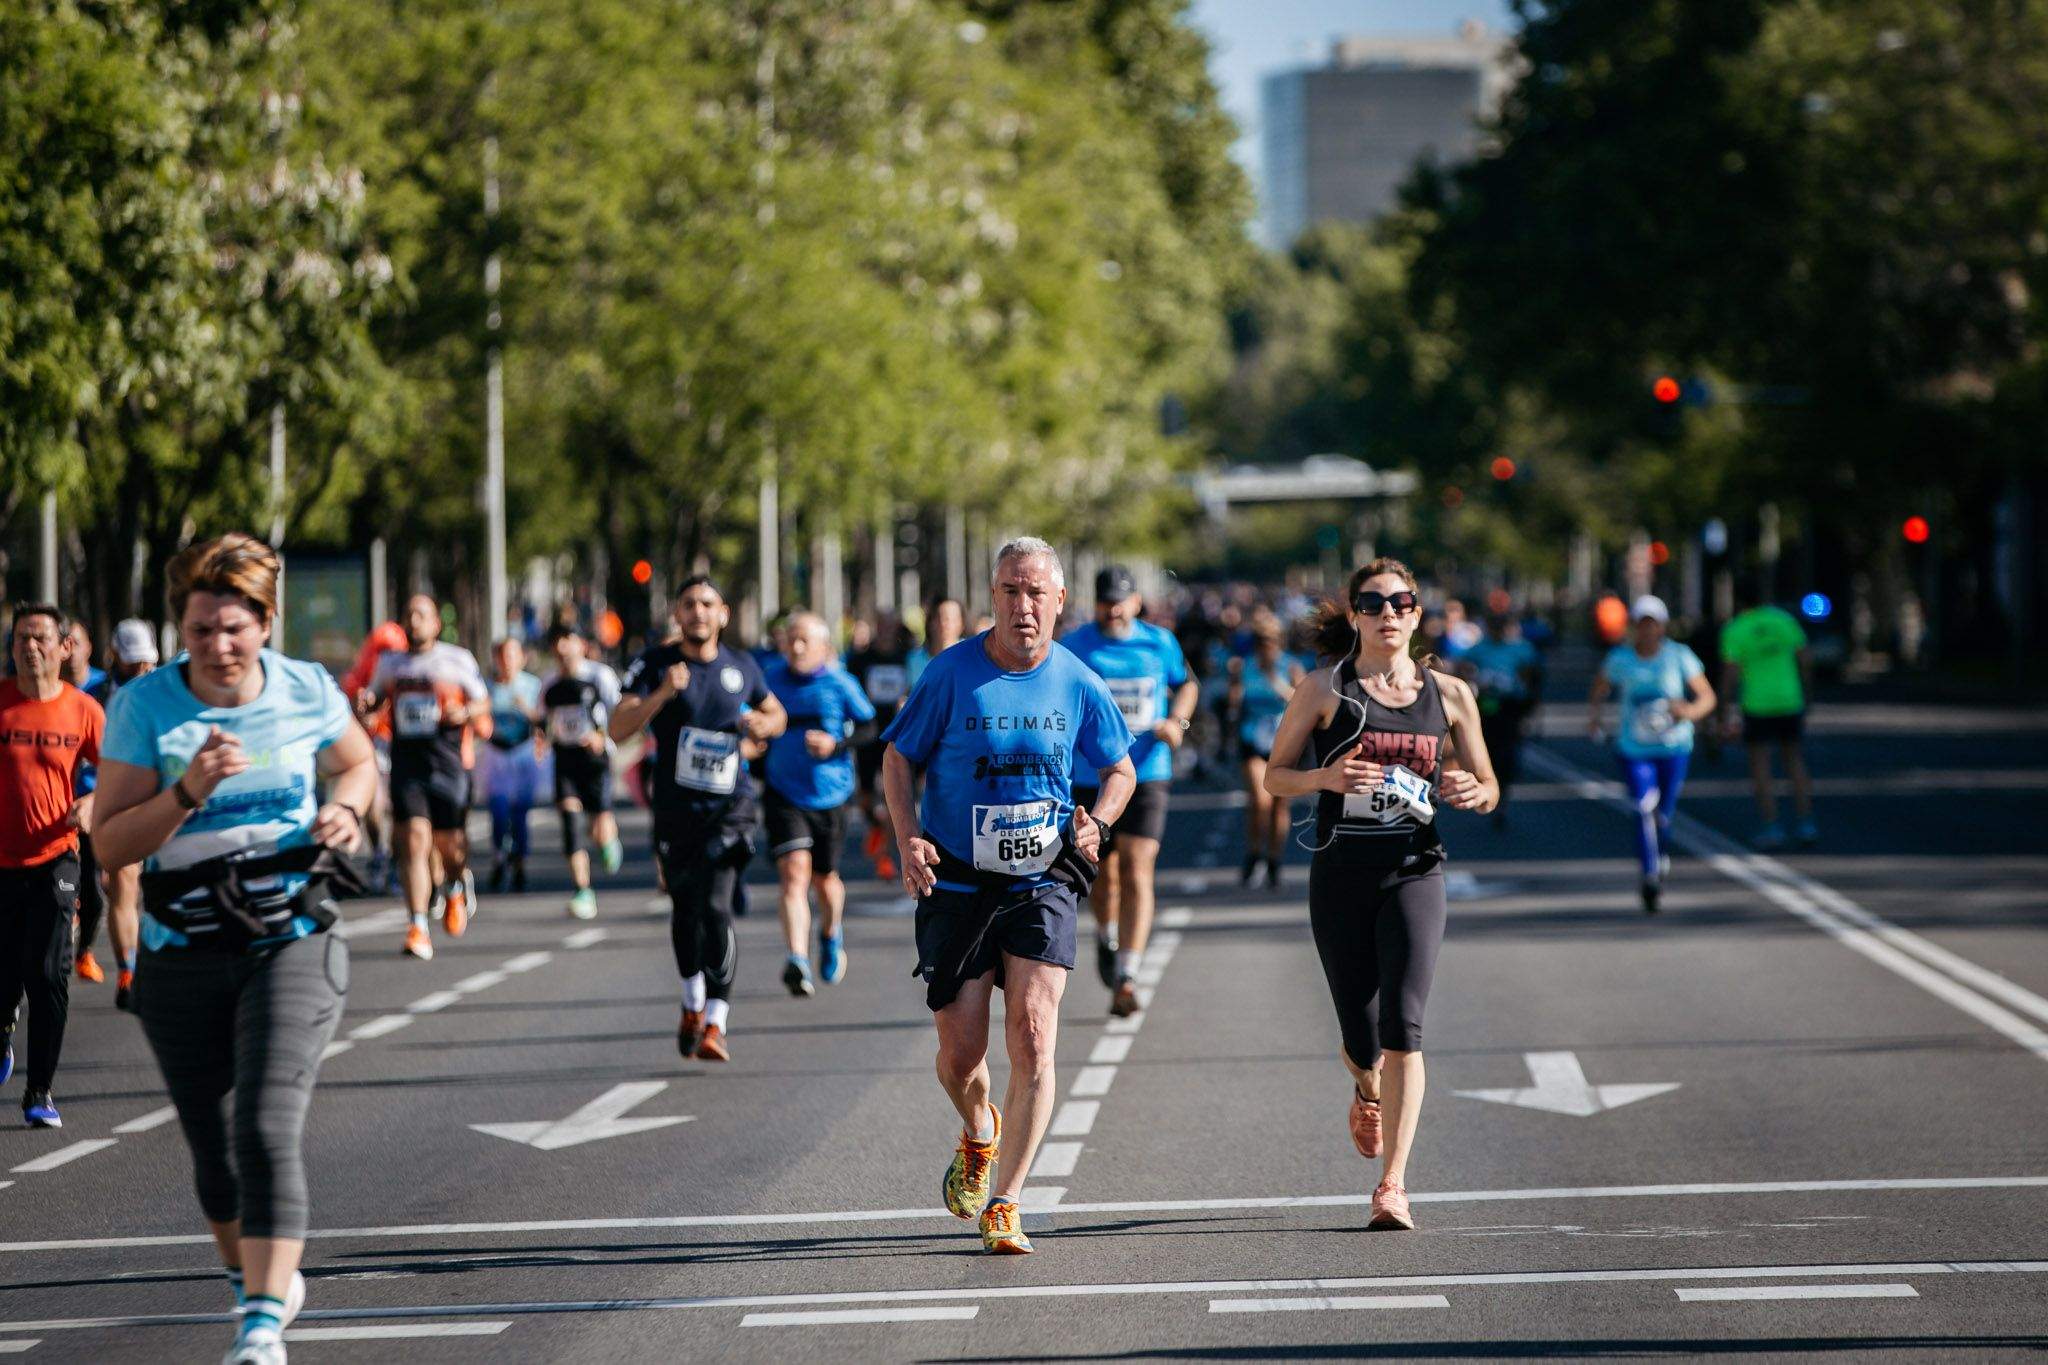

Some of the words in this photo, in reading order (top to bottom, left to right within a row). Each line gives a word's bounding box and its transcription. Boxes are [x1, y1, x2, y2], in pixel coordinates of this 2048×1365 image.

[965, 716, 1066, 731] DECIMAS
[1361, 731, 1438, 761] SWEAT
[997, 755, 1062, 765] BOMBEROS
[1000, 826, 1043, 837] DECIMAS
[998, 835, 1043, 861] 655
